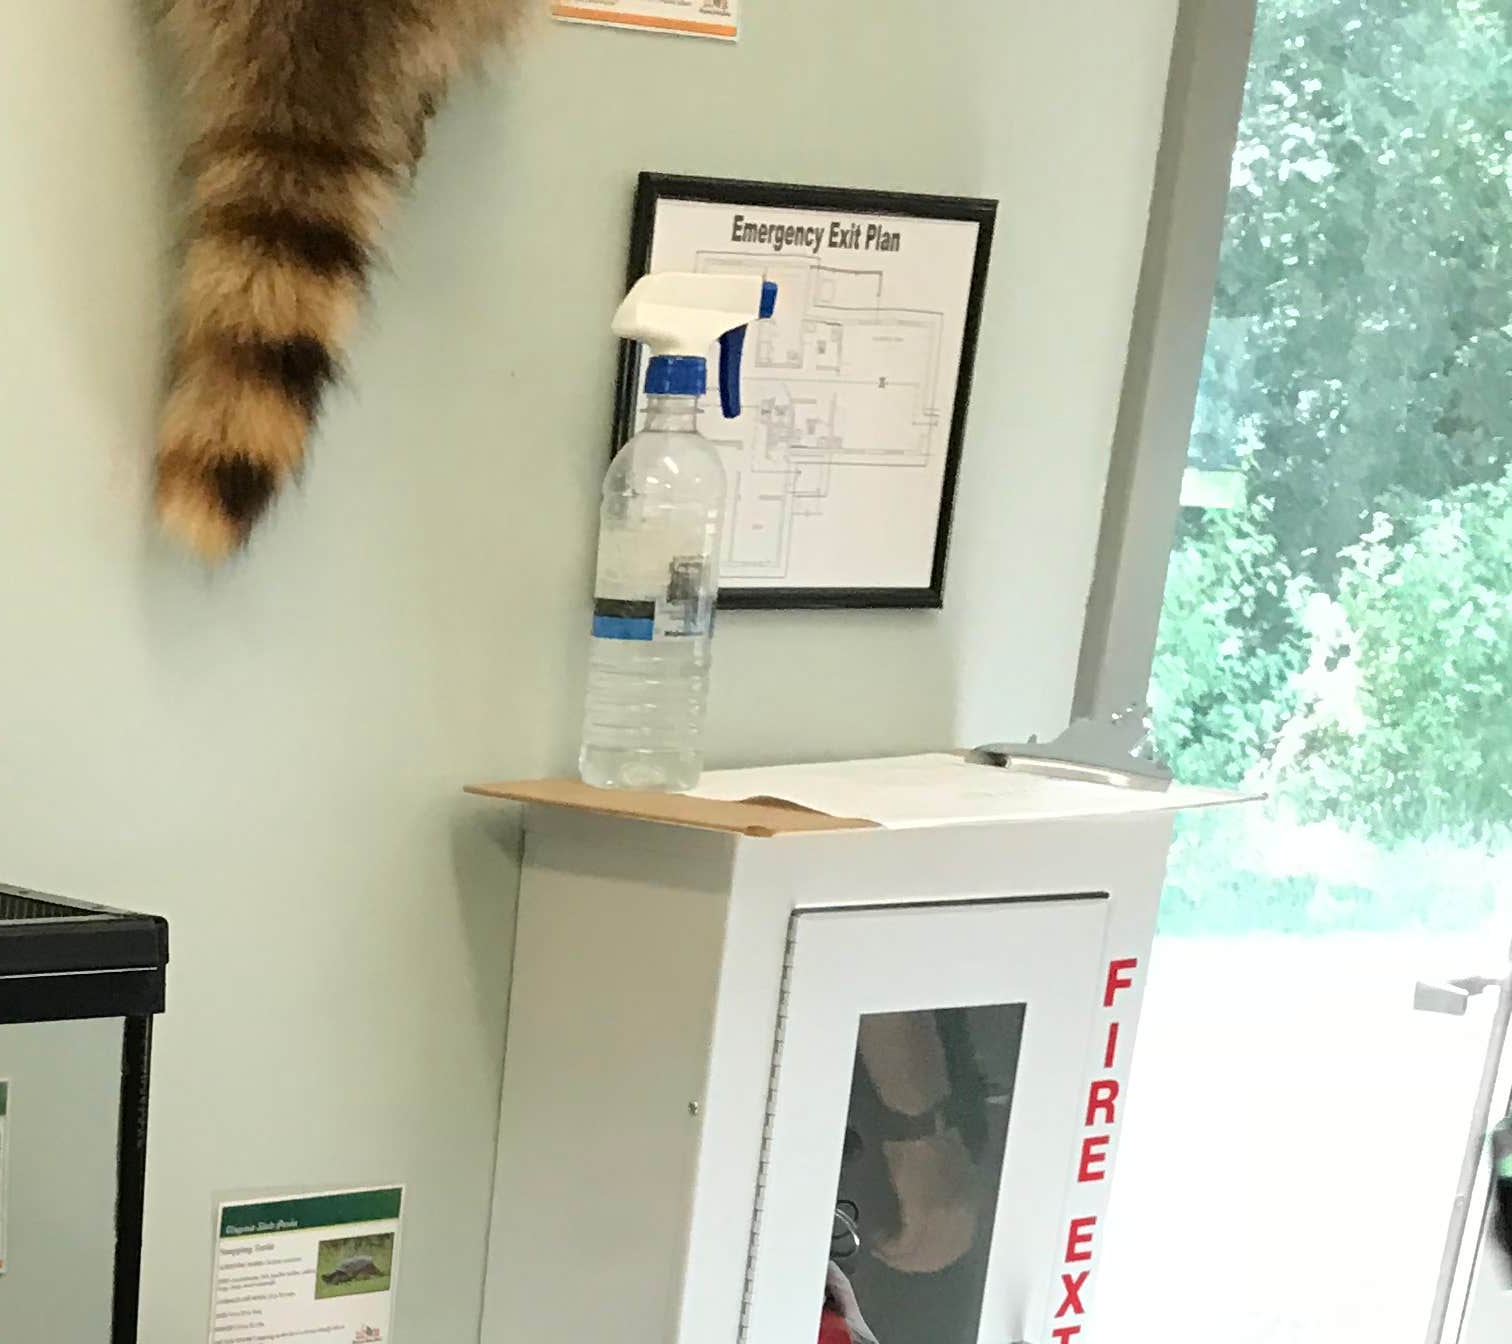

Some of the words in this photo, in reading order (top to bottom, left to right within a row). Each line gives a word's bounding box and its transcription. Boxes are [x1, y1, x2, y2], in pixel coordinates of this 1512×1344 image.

[731, 214, 824, 253] Emergency
[828, 222, 861, 250] Exit
[865, 224, 900, 252] Plan
[1076, 957, 1138, 1184] FIRE
